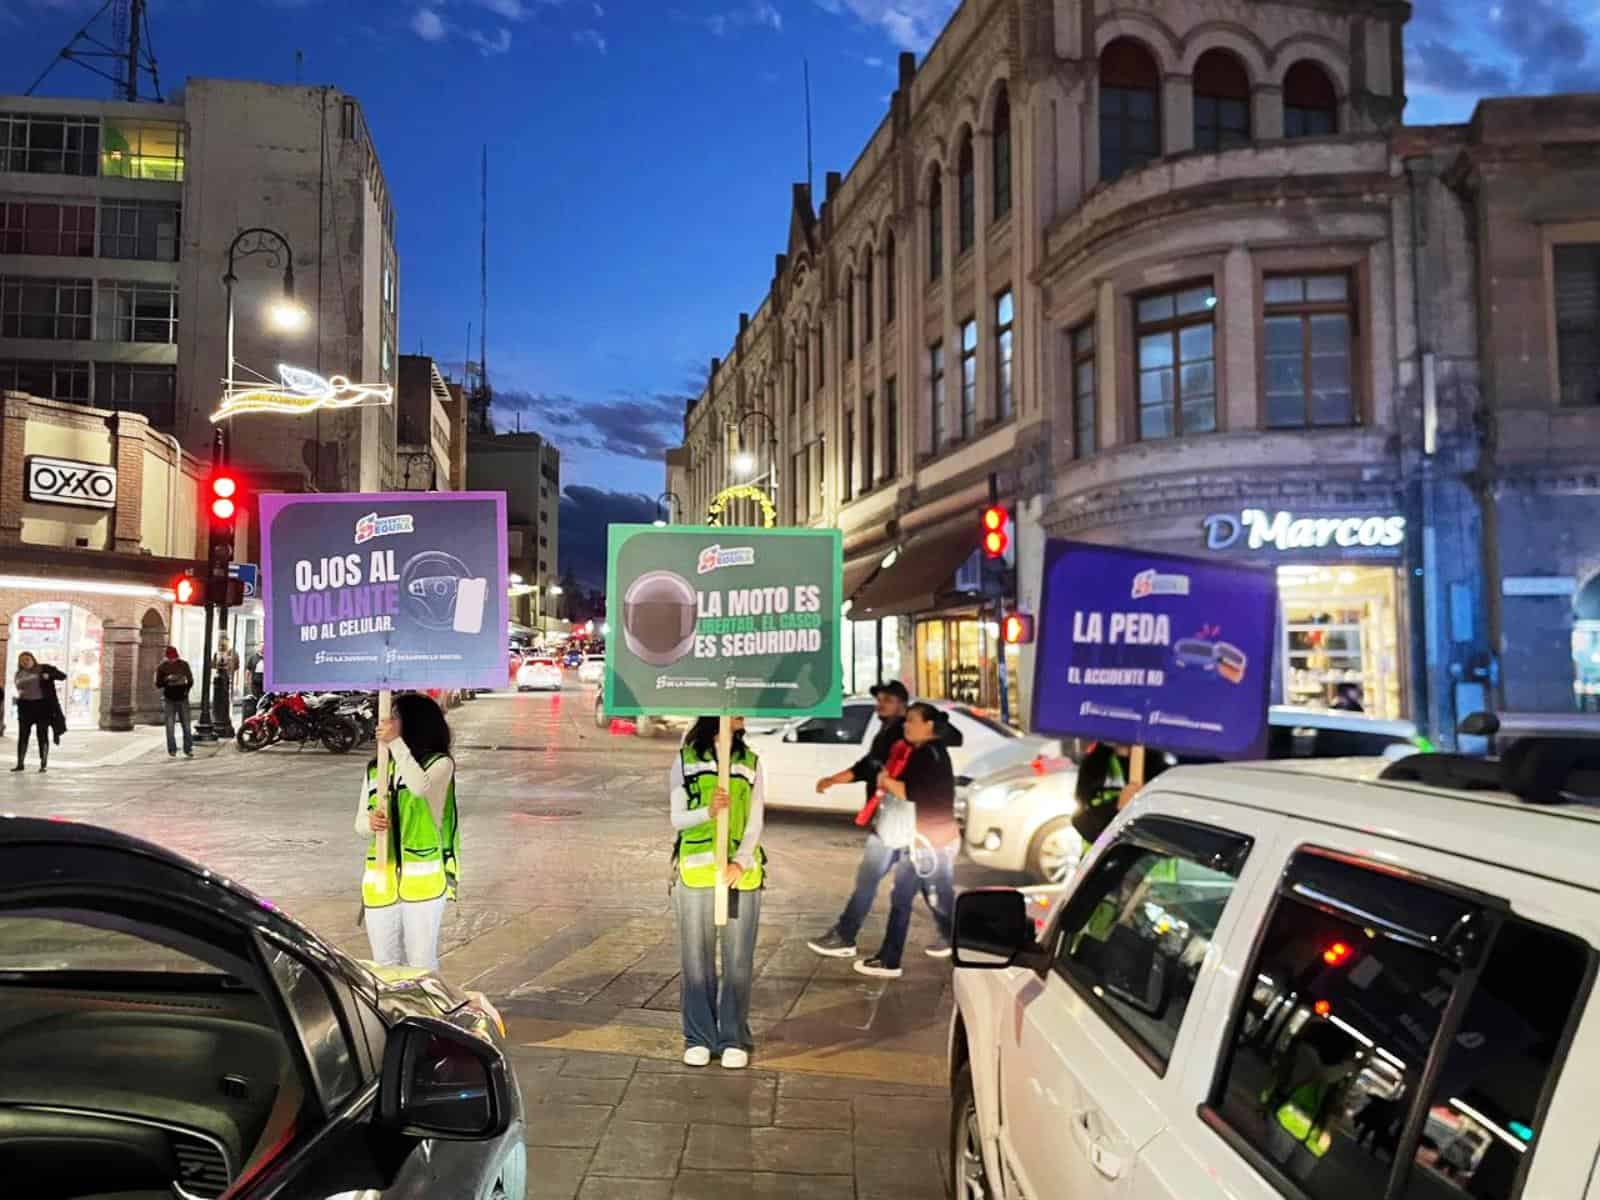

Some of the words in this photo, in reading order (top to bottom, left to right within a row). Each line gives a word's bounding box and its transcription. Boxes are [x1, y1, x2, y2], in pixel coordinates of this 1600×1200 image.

[34, 466, 113, 498] OXXO
[296, 554, 361, 592] OJOS
[369, 550, 400, 583] AL
[290, 584, 400, 625] VOLANTE
[697, 591, 722, 618] LA
[728, 587, 788, 616] MOTO
[795, 585, 821, 612] ES
[301, 625, 318, 641] NO
[321, 622, 336, 640] AL
[339, 615, 396, 635] CELULAR.
[762, 615, 777, 631] EL
[1073, 611, 1102, 644] LA
[1109, 613, 1170, 646] PEDA
[694, 634, 717, 658] ES
[721, 629, 821, 657] SEGURIDAD
[1068, 667, 1080, 684] EL
[1084, 668, 1145, 686] ACCIDENTE
